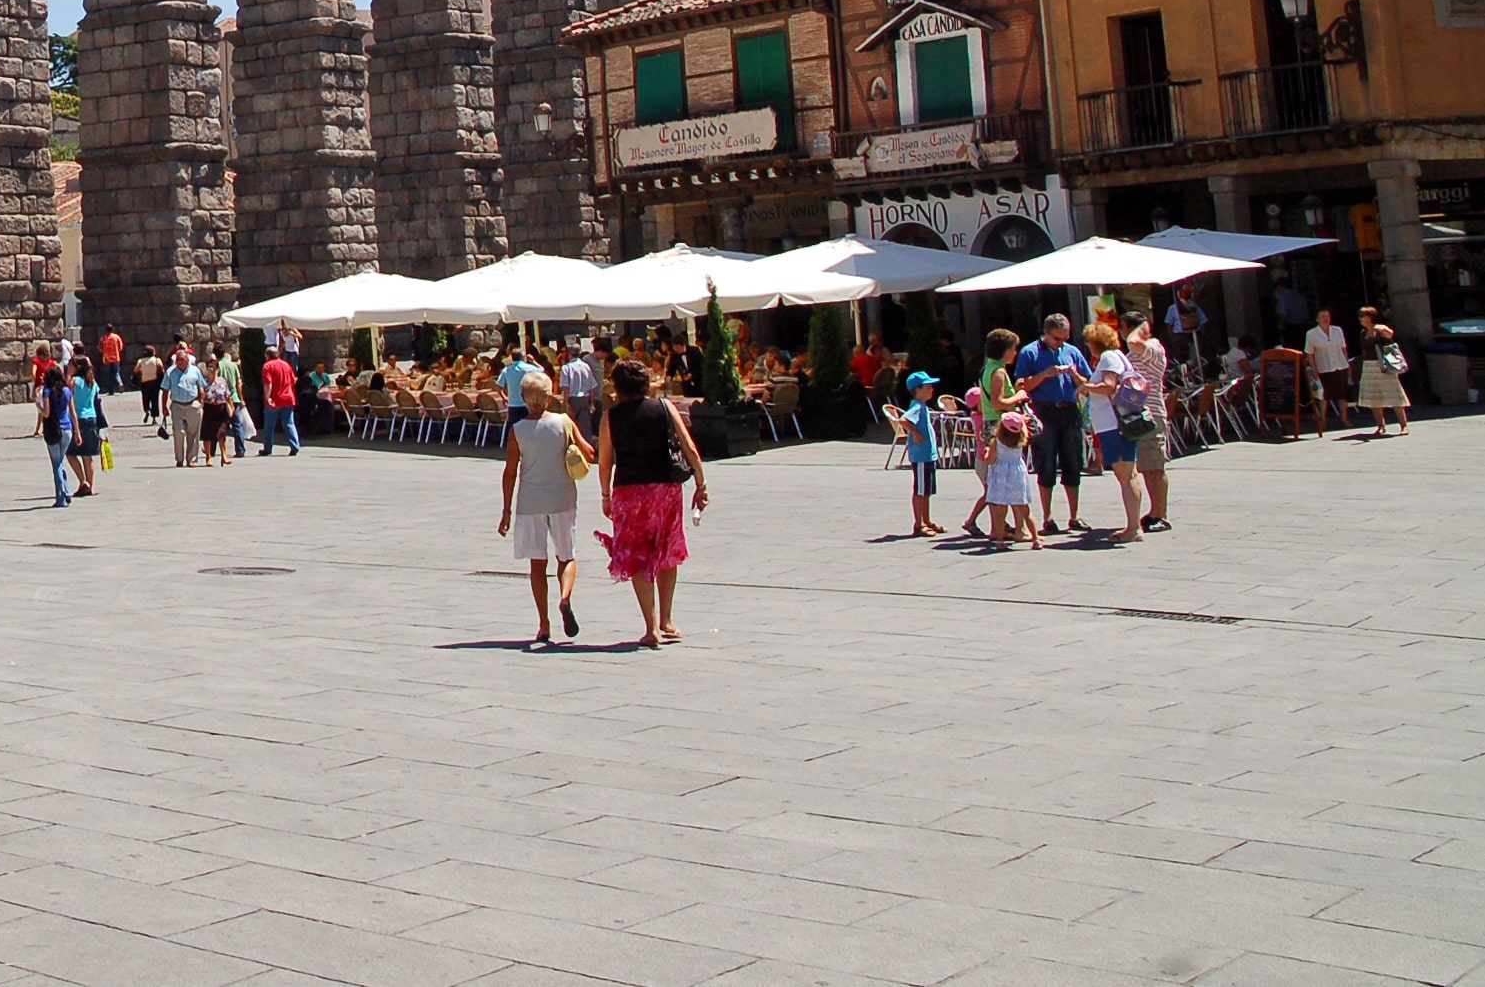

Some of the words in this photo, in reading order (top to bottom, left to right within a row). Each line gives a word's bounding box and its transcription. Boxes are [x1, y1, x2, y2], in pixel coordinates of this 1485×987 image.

[901, 20, 926, 41] CASA
[629, 144, 675, 161] Mesonero
[675, 141, 707, 156] Mayor
[710, 140, 722, 150] de
[725, 135, 762, 148] Castilla
[869, 201, 948, 240] HORNO
[952, 233, 966, 248] DE
[977, 192, 1051, 234] ASAR
